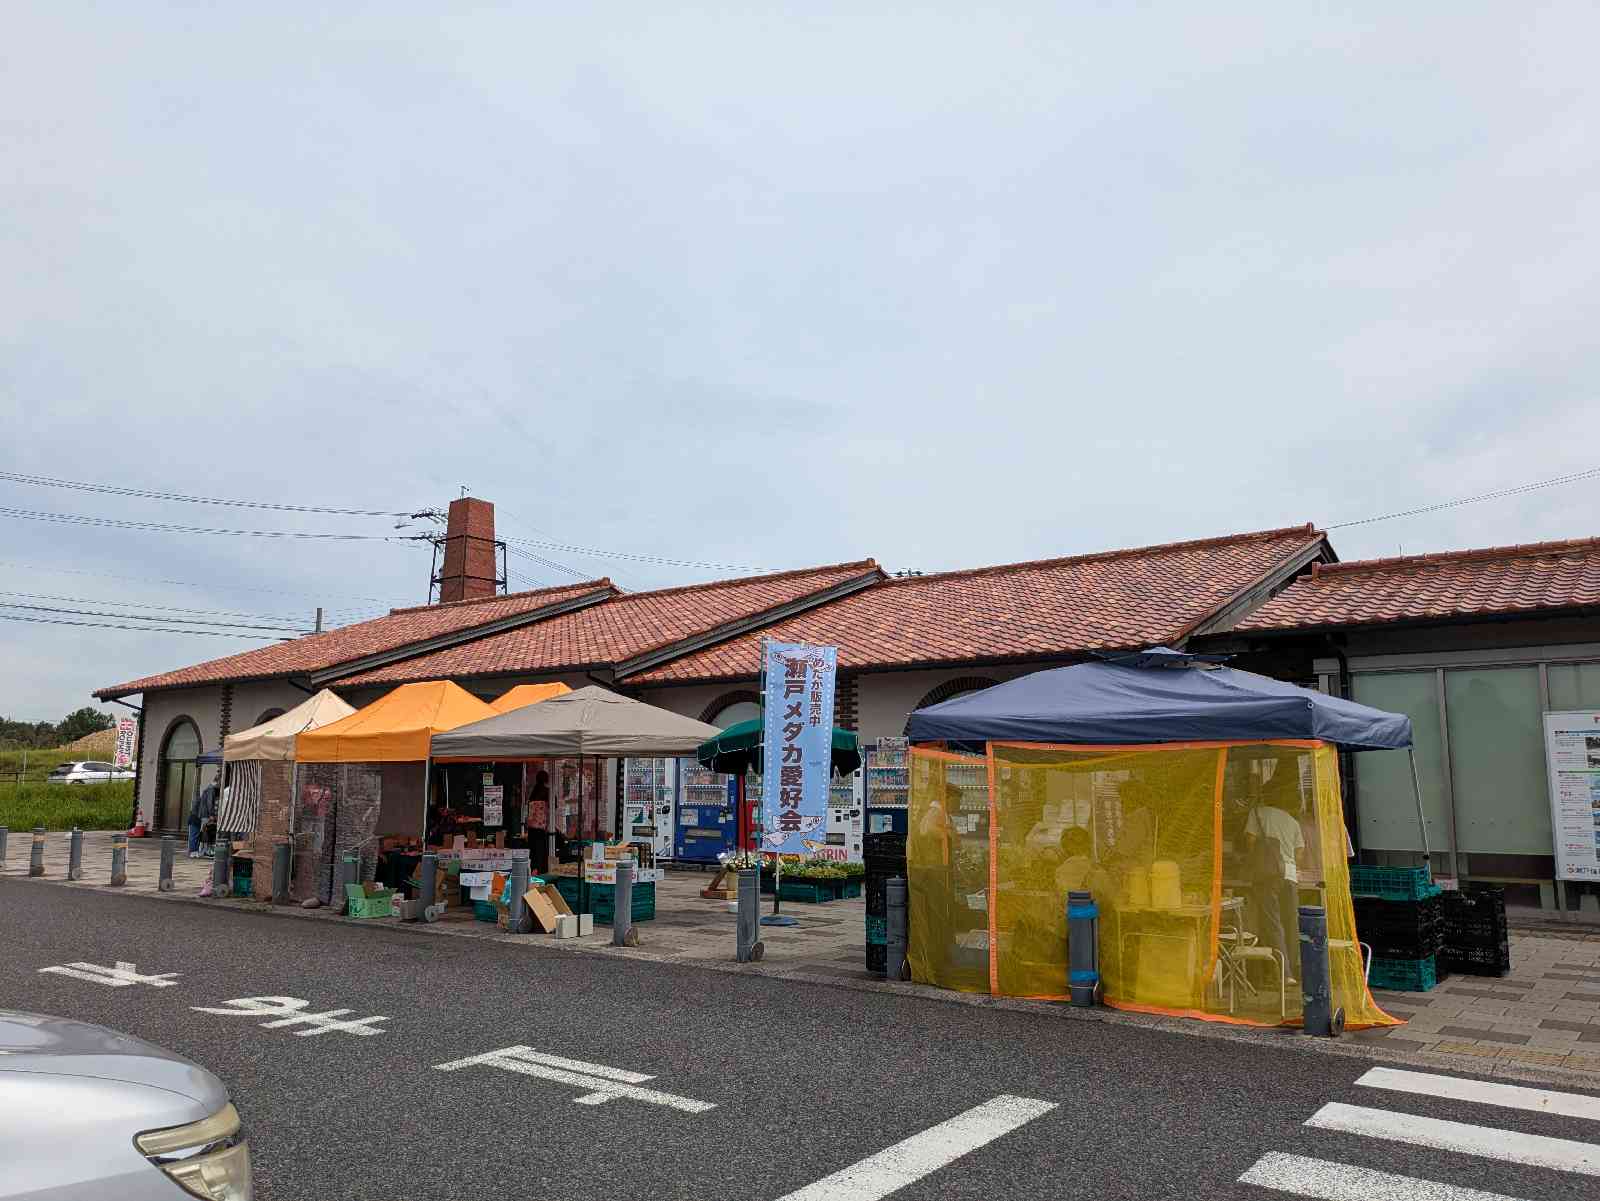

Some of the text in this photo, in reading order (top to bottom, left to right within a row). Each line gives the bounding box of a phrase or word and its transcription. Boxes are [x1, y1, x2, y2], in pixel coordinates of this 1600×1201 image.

[780, 657, 808, 831] 瀬戸メダカ愛好会
